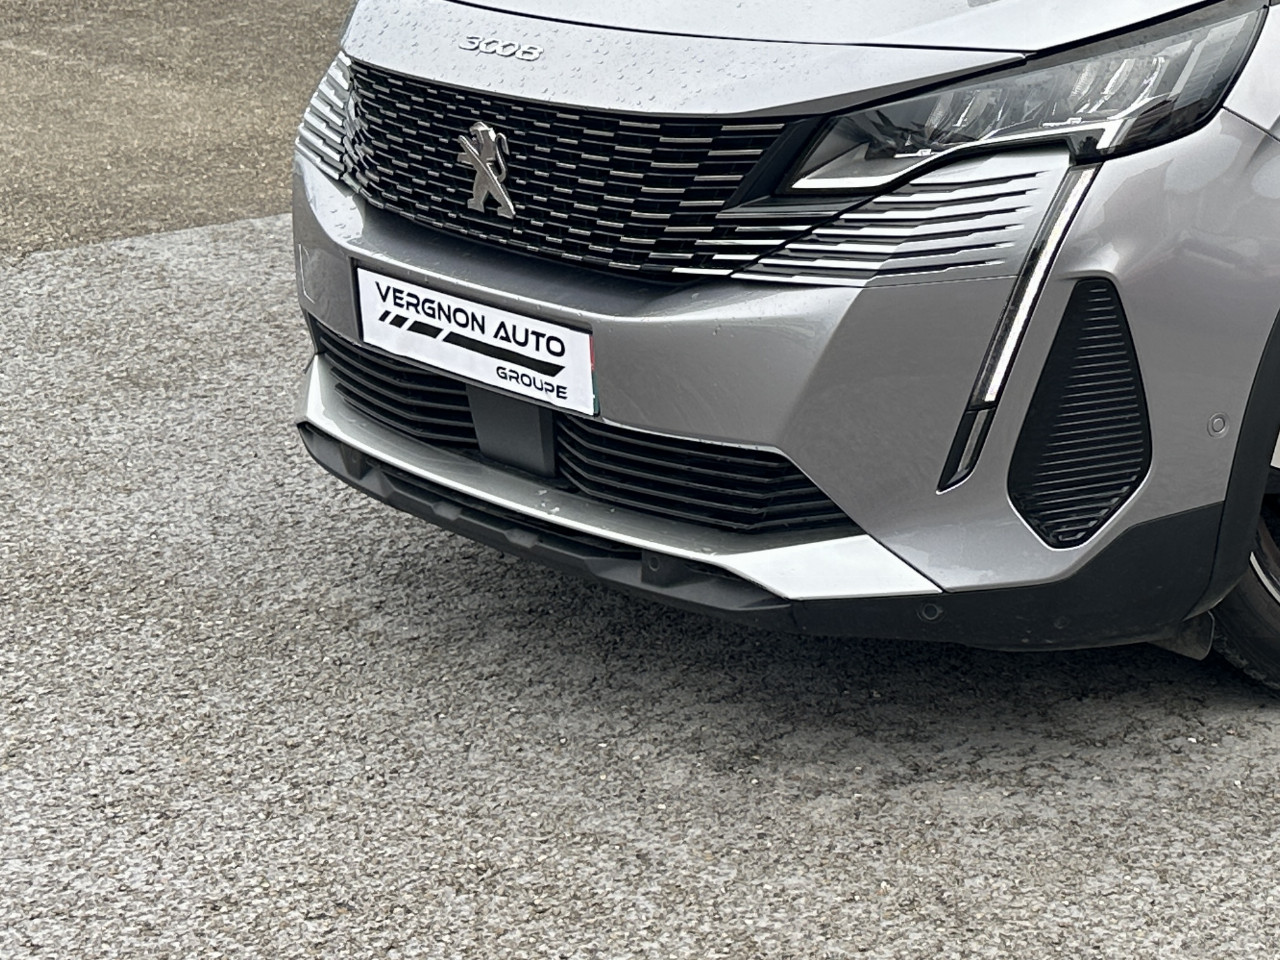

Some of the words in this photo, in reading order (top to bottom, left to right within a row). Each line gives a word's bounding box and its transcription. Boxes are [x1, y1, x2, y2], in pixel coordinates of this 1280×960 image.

[458, 35, 544, 61] 3008
[375, 281, 485, 335] VERGNON
[493, 321, 566, 358] AUTO
[496, 366, 568, 400] GROUPE
